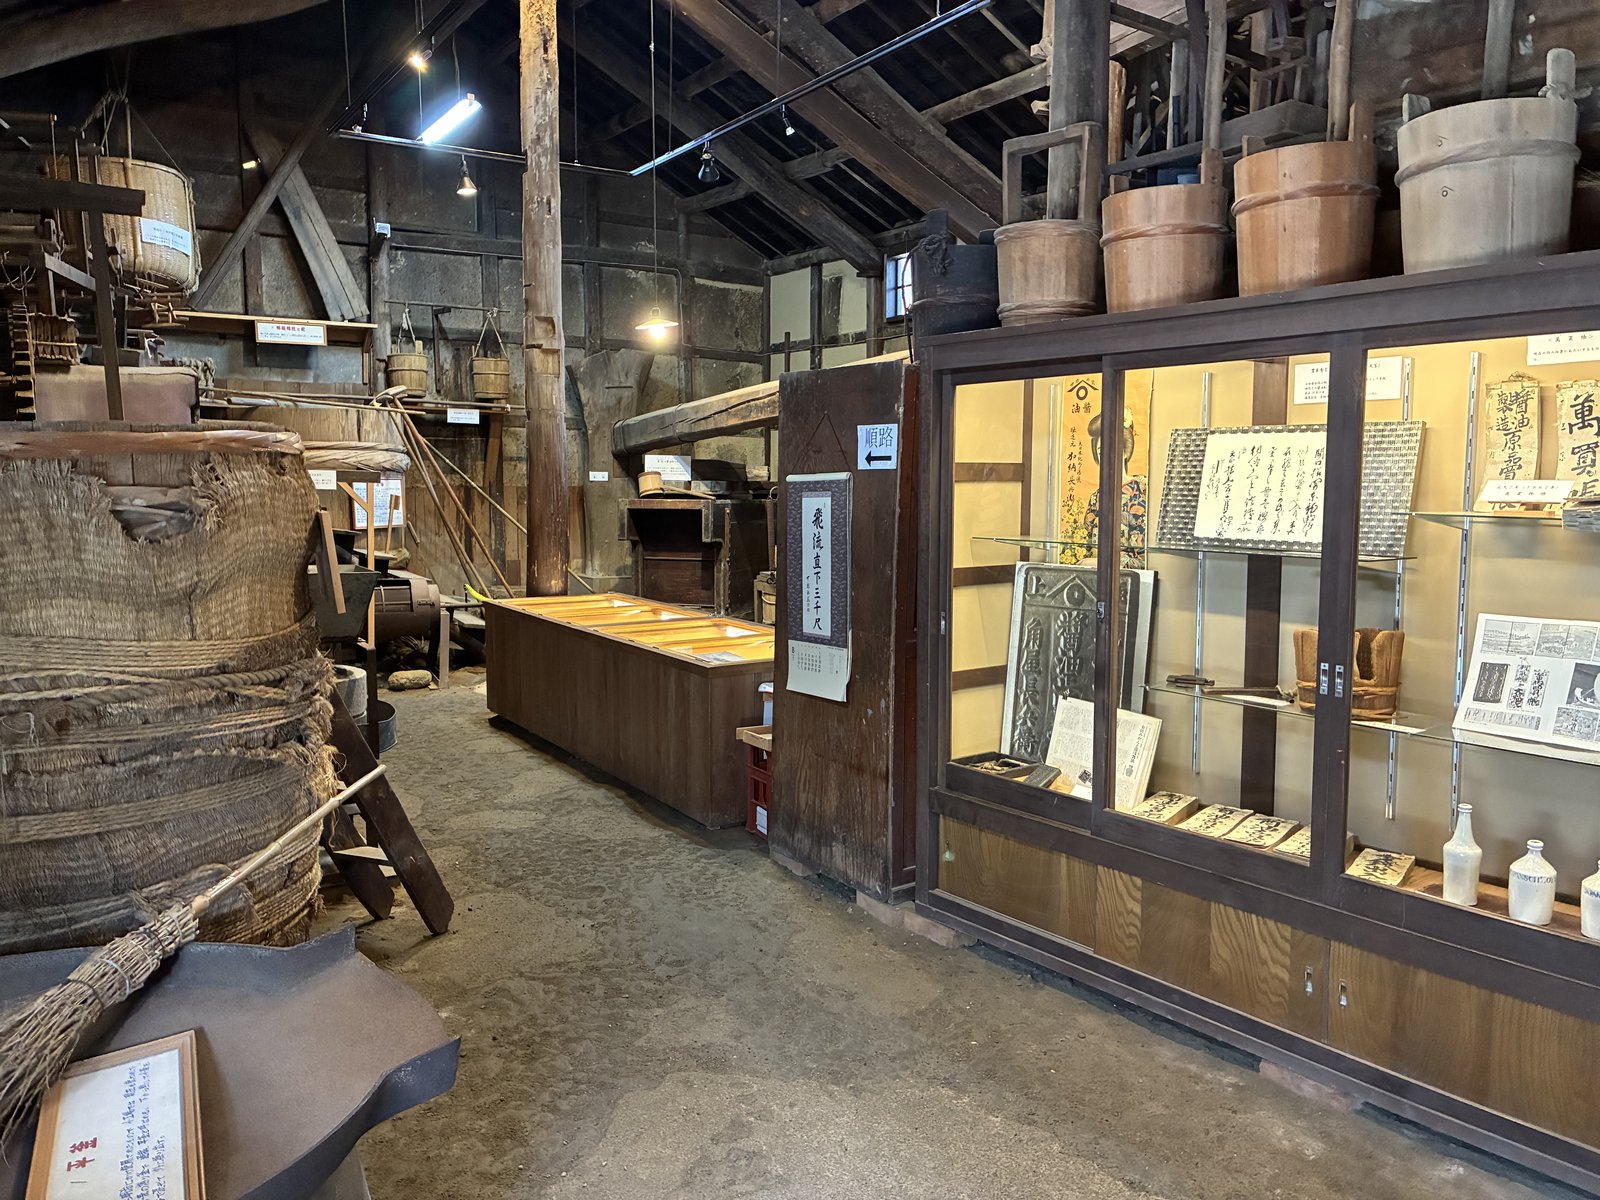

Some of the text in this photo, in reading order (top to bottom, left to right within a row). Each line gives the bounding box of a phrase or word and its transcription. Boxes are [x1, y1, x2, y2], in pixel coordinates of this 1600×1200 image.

[864, 426, 894, 449] 順路
[811, 507, 825, 631] 飛流直下三千尺
